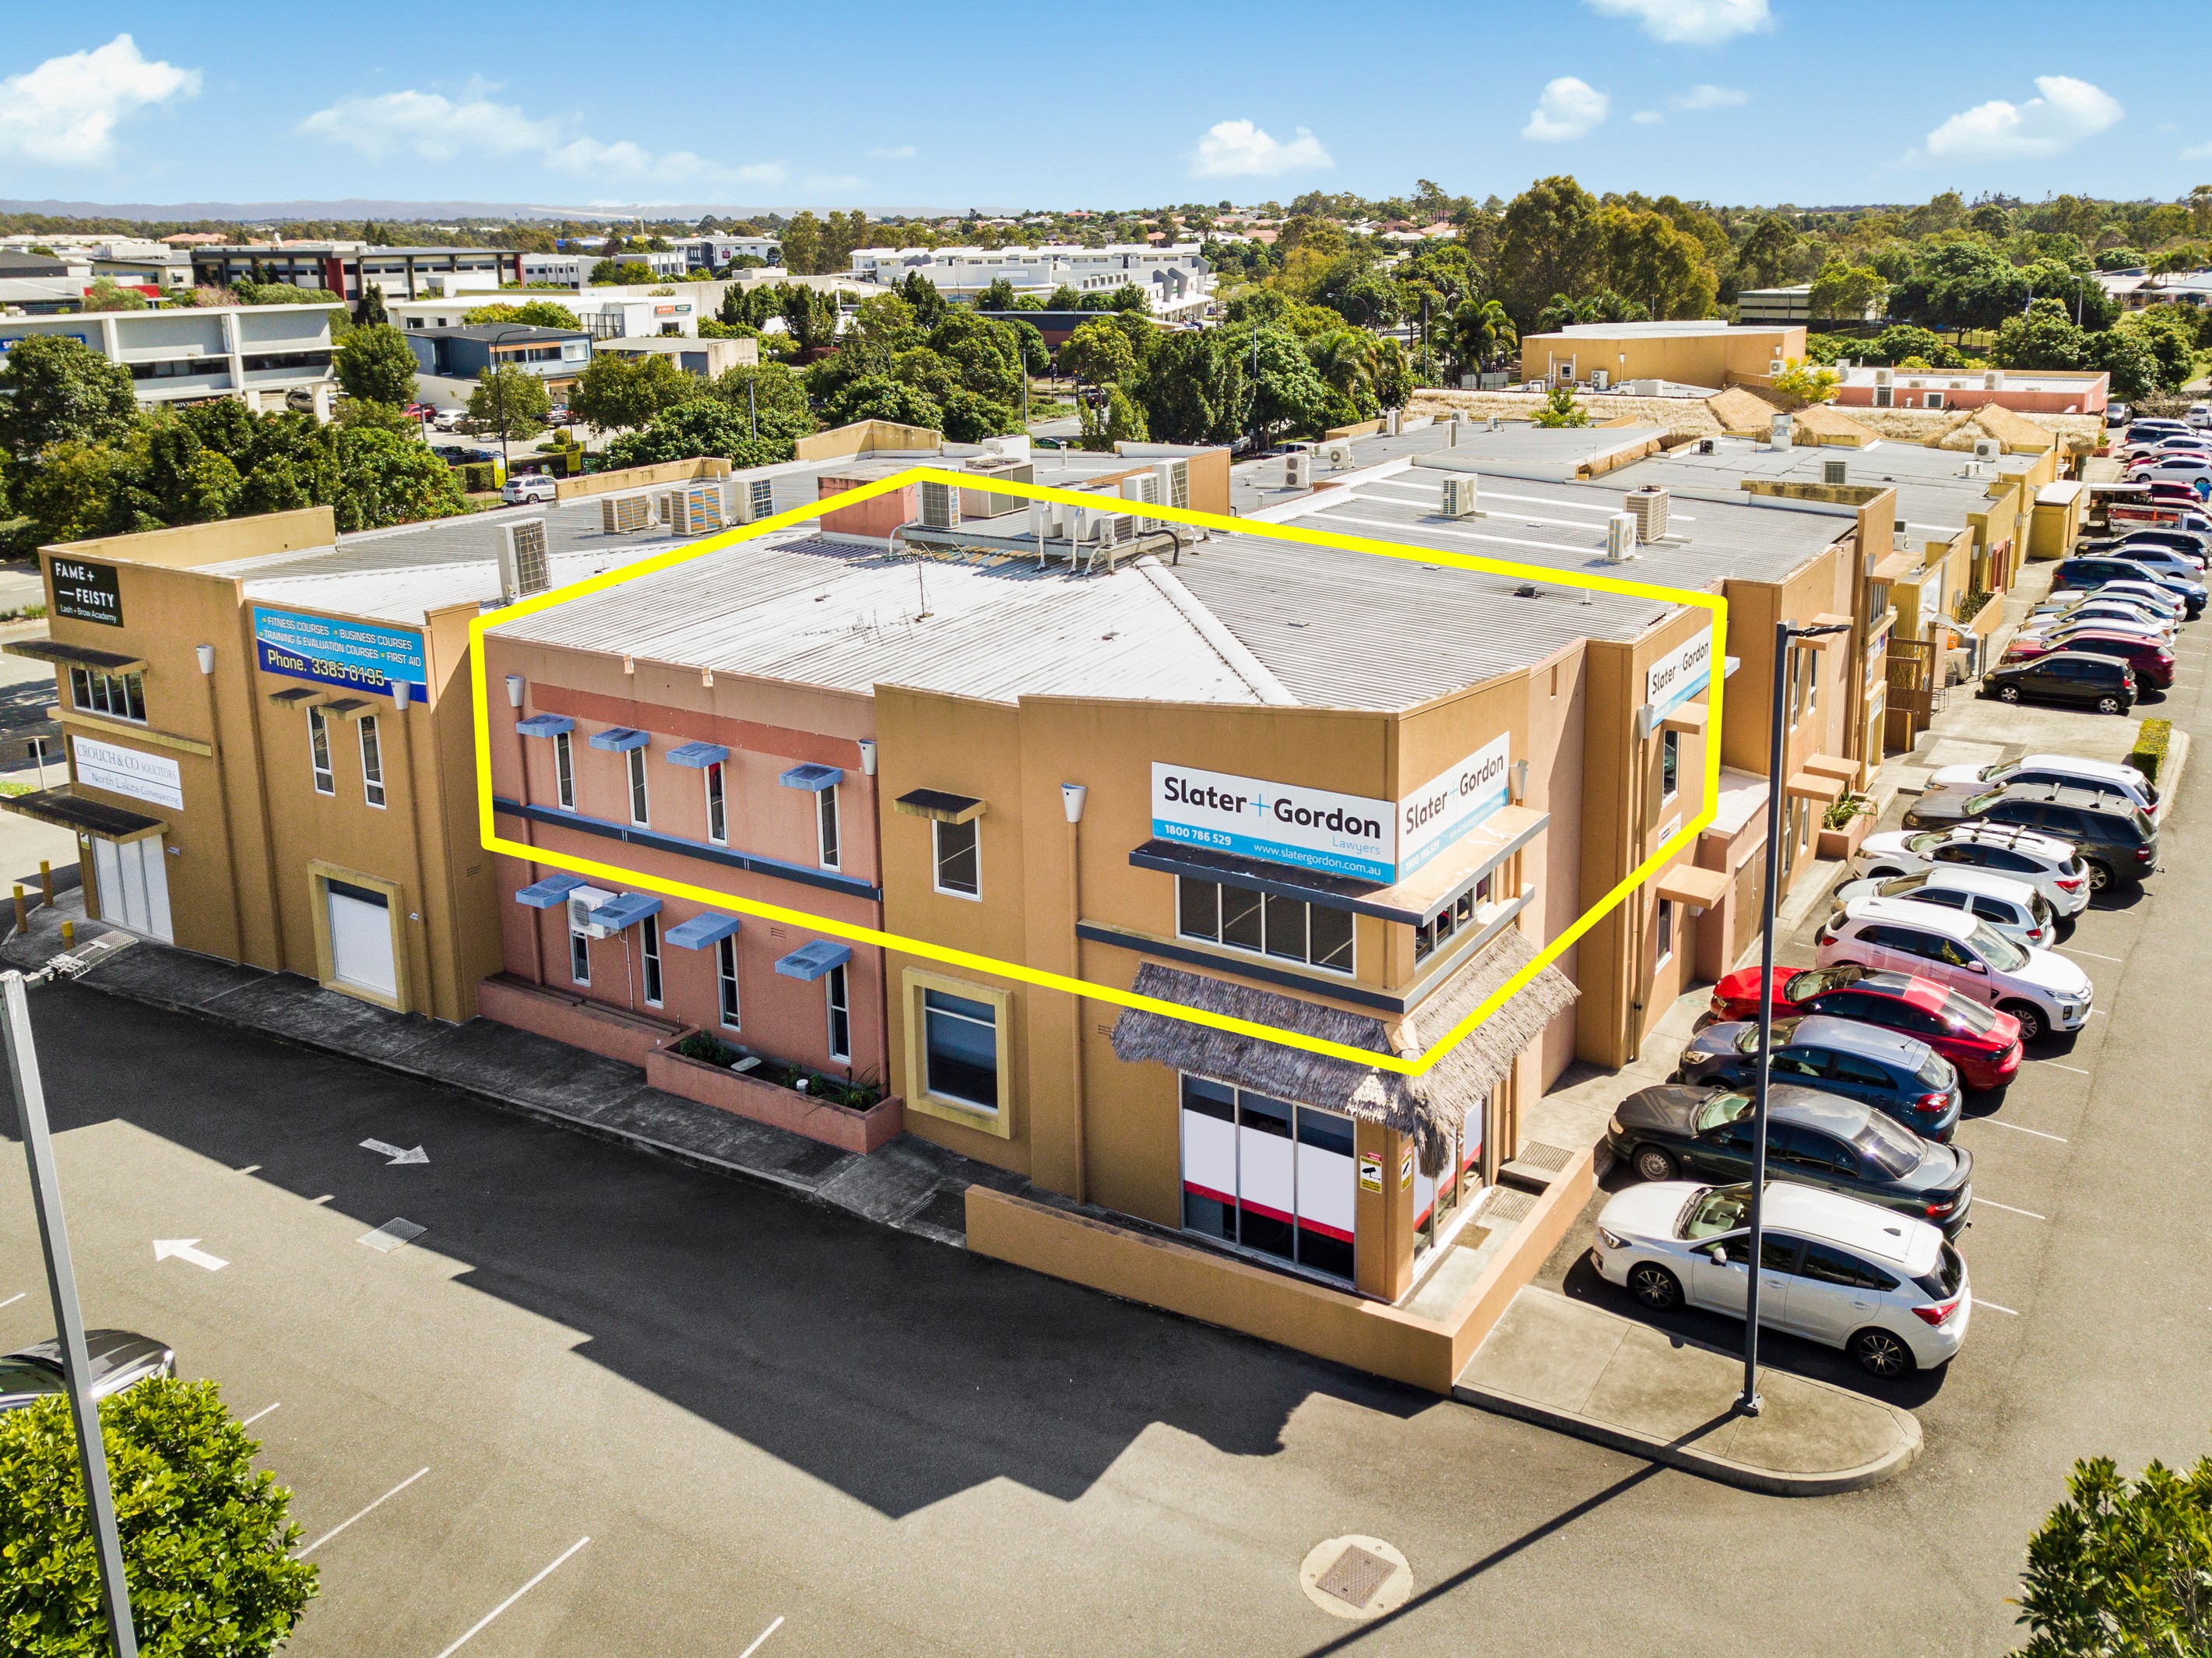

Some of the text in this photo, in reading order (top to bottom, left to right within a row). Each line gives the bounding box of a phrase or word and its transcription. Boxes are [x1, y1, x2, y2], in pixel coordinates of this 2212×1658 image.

[55, 562, 85, 580] FAME
[60, 604, 72, 614] Lash
[77, 607, 90, 617] Brow
[91, 610, 117, 623] Academy
[76, 588, 114, 607] FEISTY
[264, 629, 420, 667] TRAINING & EVALUATION COURSES FIRST AID
[268, 616, 412, 650] FITNESS COURSES BUSINESS COURSES
[267, 648, 385, 687] Phone. 3385 0195
[1652, 665, 1676, 695] Slater
[1683, 642, 1709, 671] Gordon
[76, 744, 176, 780] CROUCH & CO SOLICITORS
[91, 772, 114, 787] North
[115, 776, 139, 793] Lakes
[1406, 791, 1447, 835] Slater
[1460, 755, 1503, 797] Gordon
[1164, 776, 1247, 813] Slater
[1274, 798, 1380, 839] Gordon
[1165, 824, 1231, 846] 1800 786 529
[1332, 836, 1380, 855] Lawyers
[1254, 843, 1381, 876] www.slatergordon.com.au
